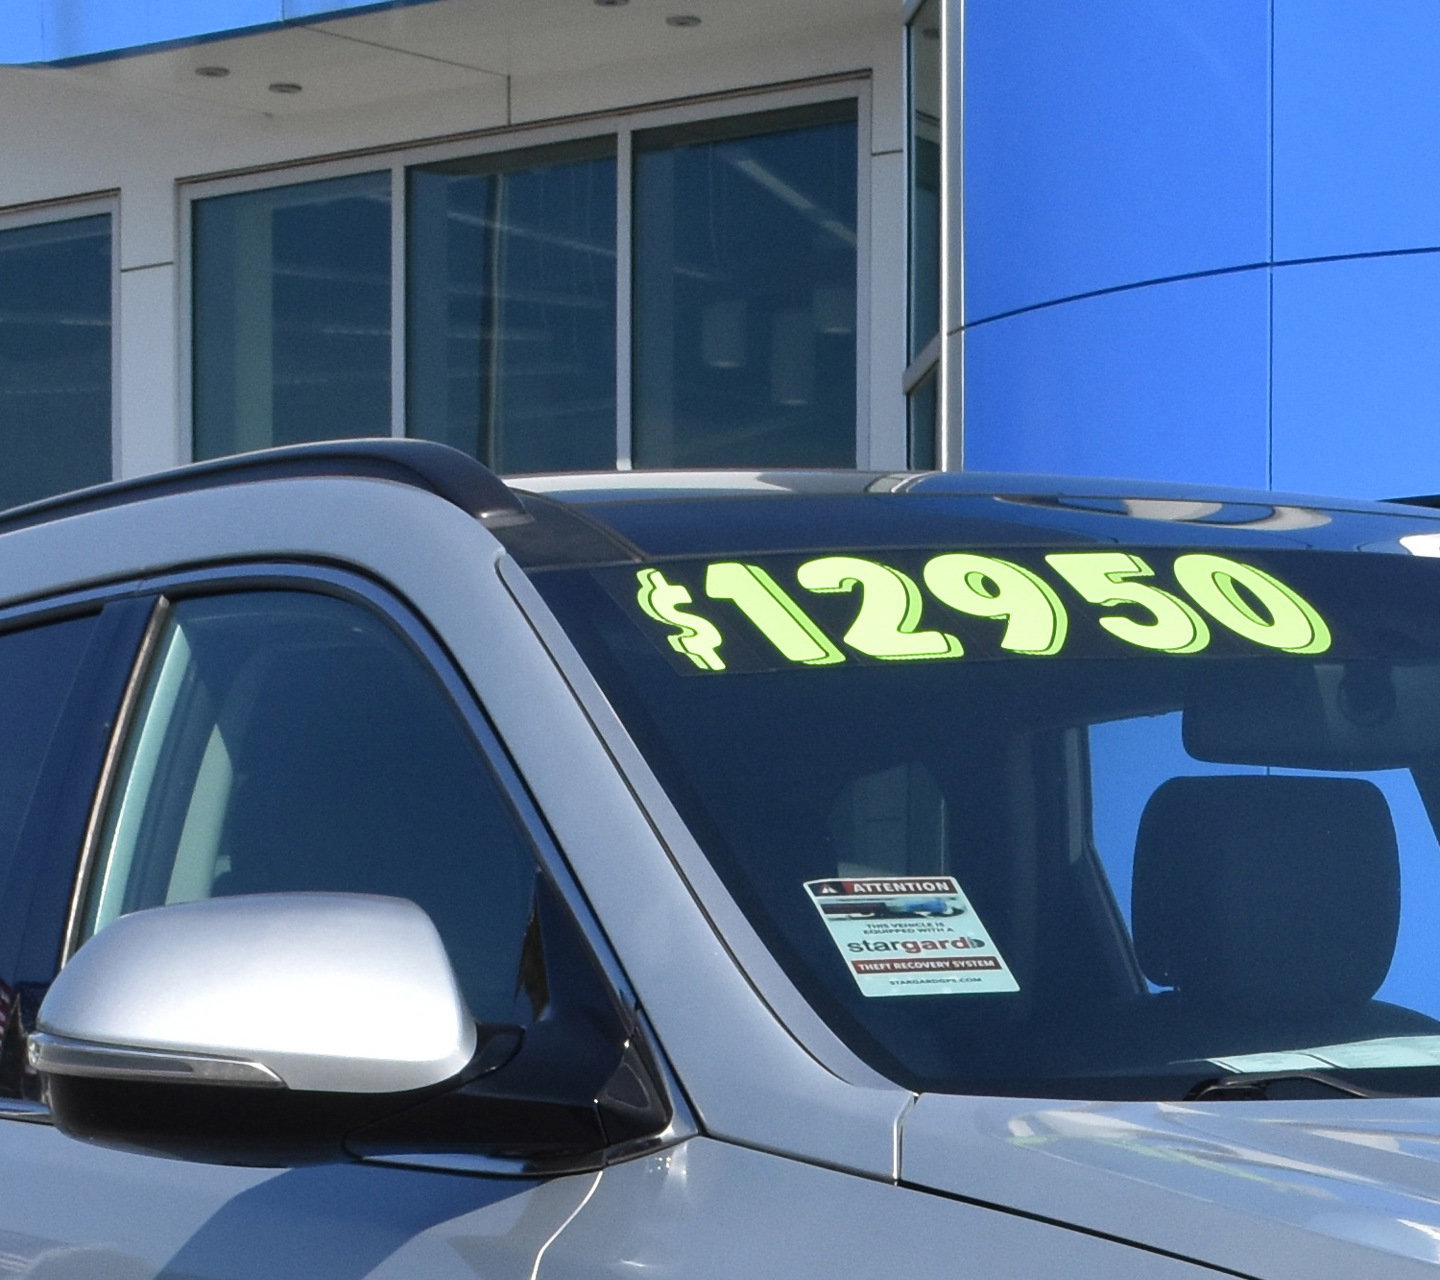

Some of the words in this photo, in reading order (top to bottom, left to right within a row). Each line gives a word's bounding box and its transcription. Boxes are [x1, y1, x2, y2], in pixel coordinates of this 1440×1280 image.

[635, 552, 1333, 672] $12950
[852, 880, 950, 895] ATTENTION
[847, 936, 970, 954] stargard
[857, 963, 891, 971] THEFT
[893, 961, 951, 970] RECOVERY
[951, 959, 995, 968] SYSTEM
